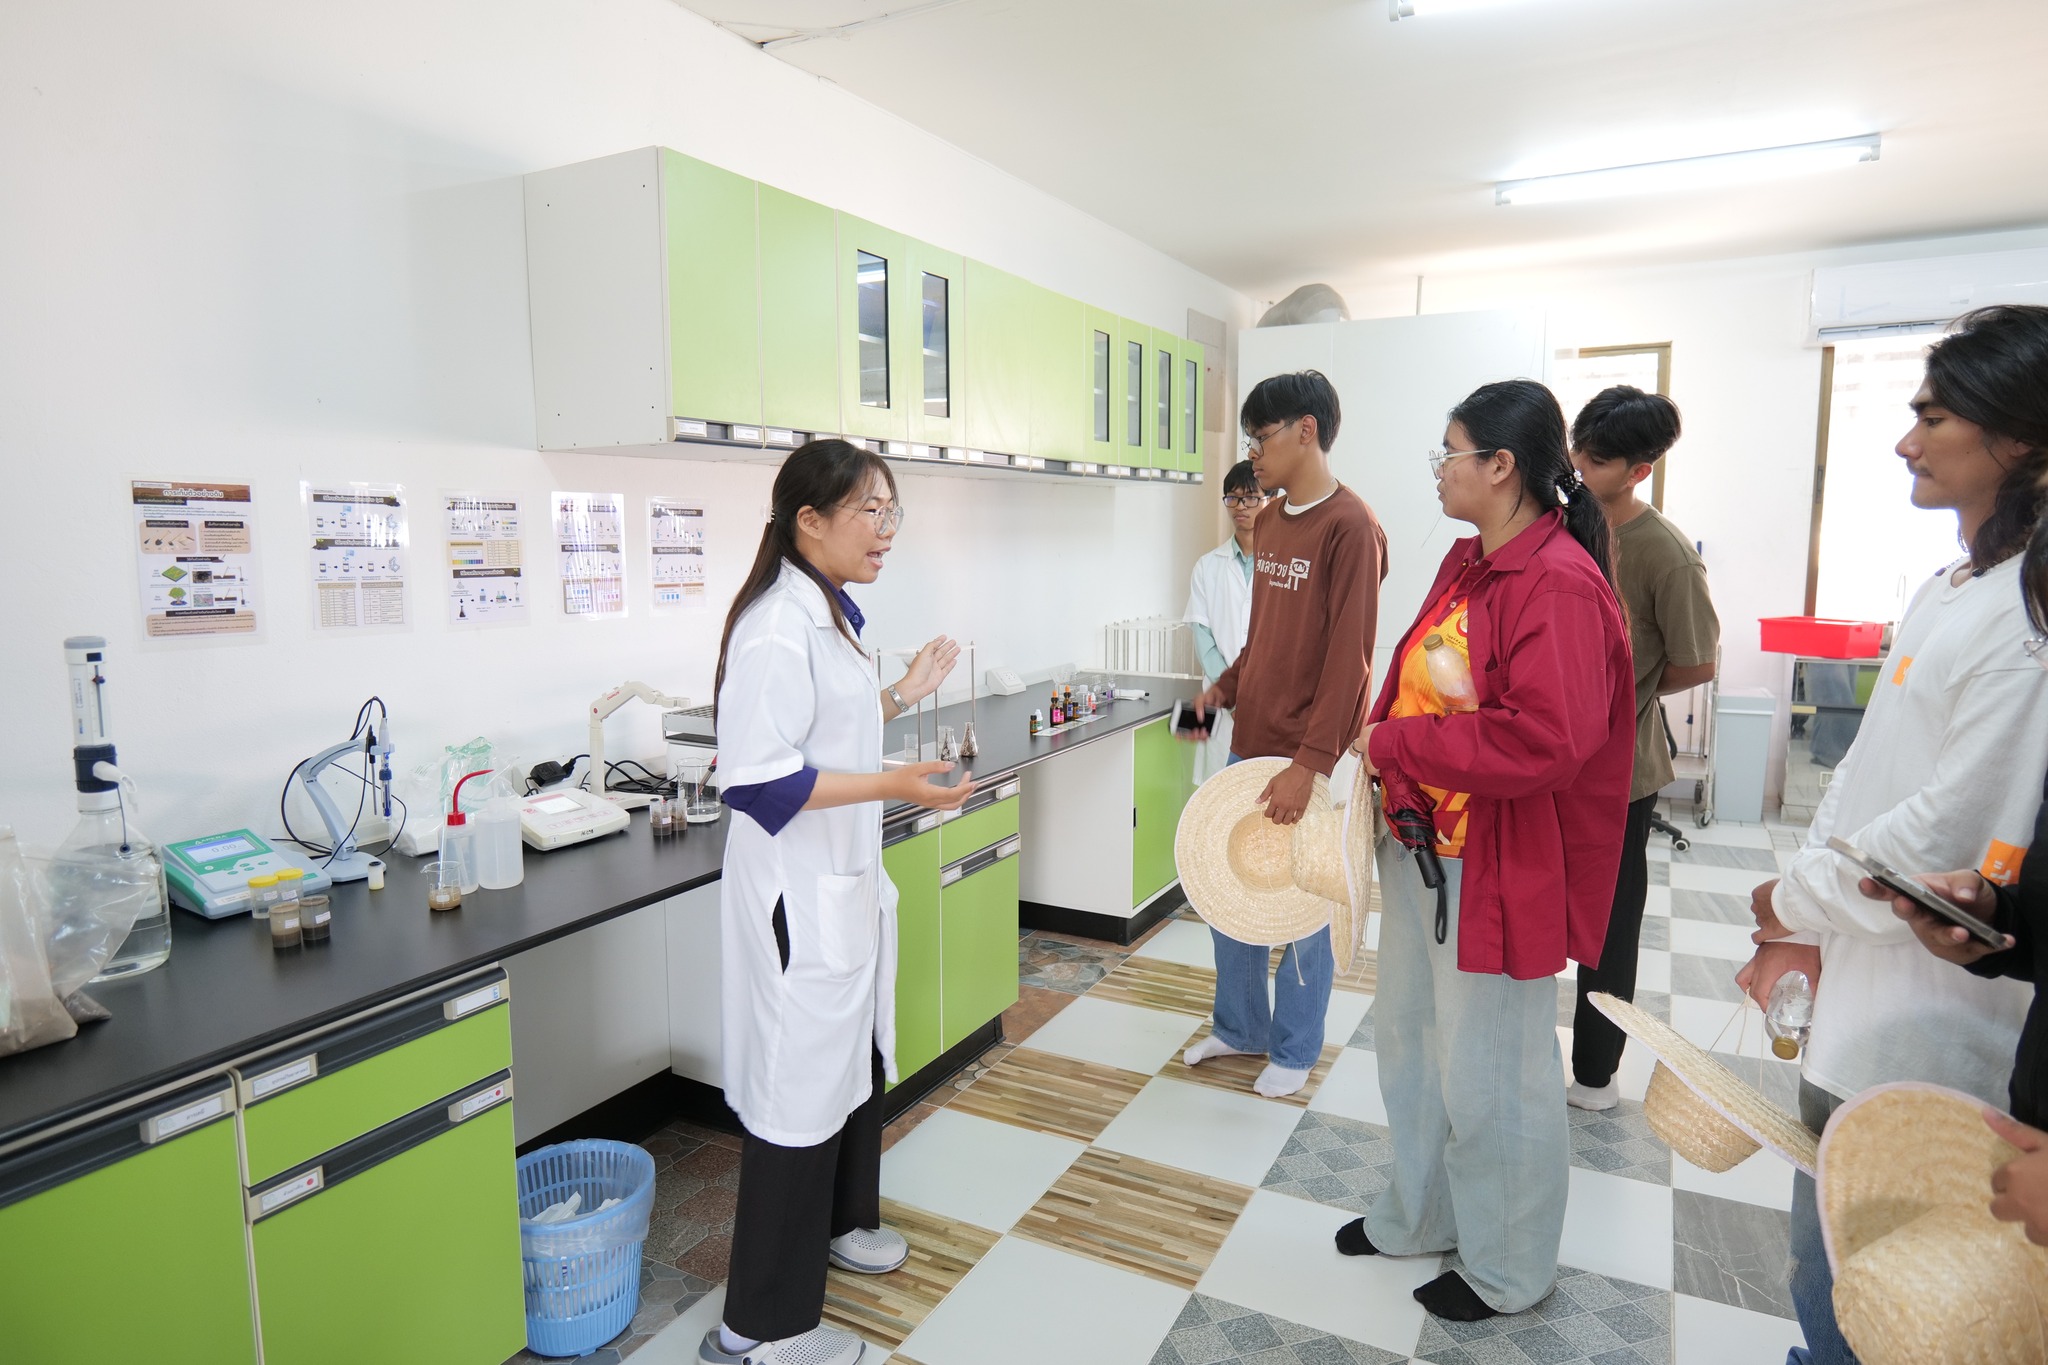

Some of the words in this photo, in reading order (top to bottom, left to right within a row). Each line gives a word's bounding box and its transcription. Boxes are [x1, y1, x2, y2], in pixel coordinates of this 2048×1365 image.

[163, 487, 224, 498] การเก็บตัวอย่างดิน
[211, 843, 237, 853] 0.00
